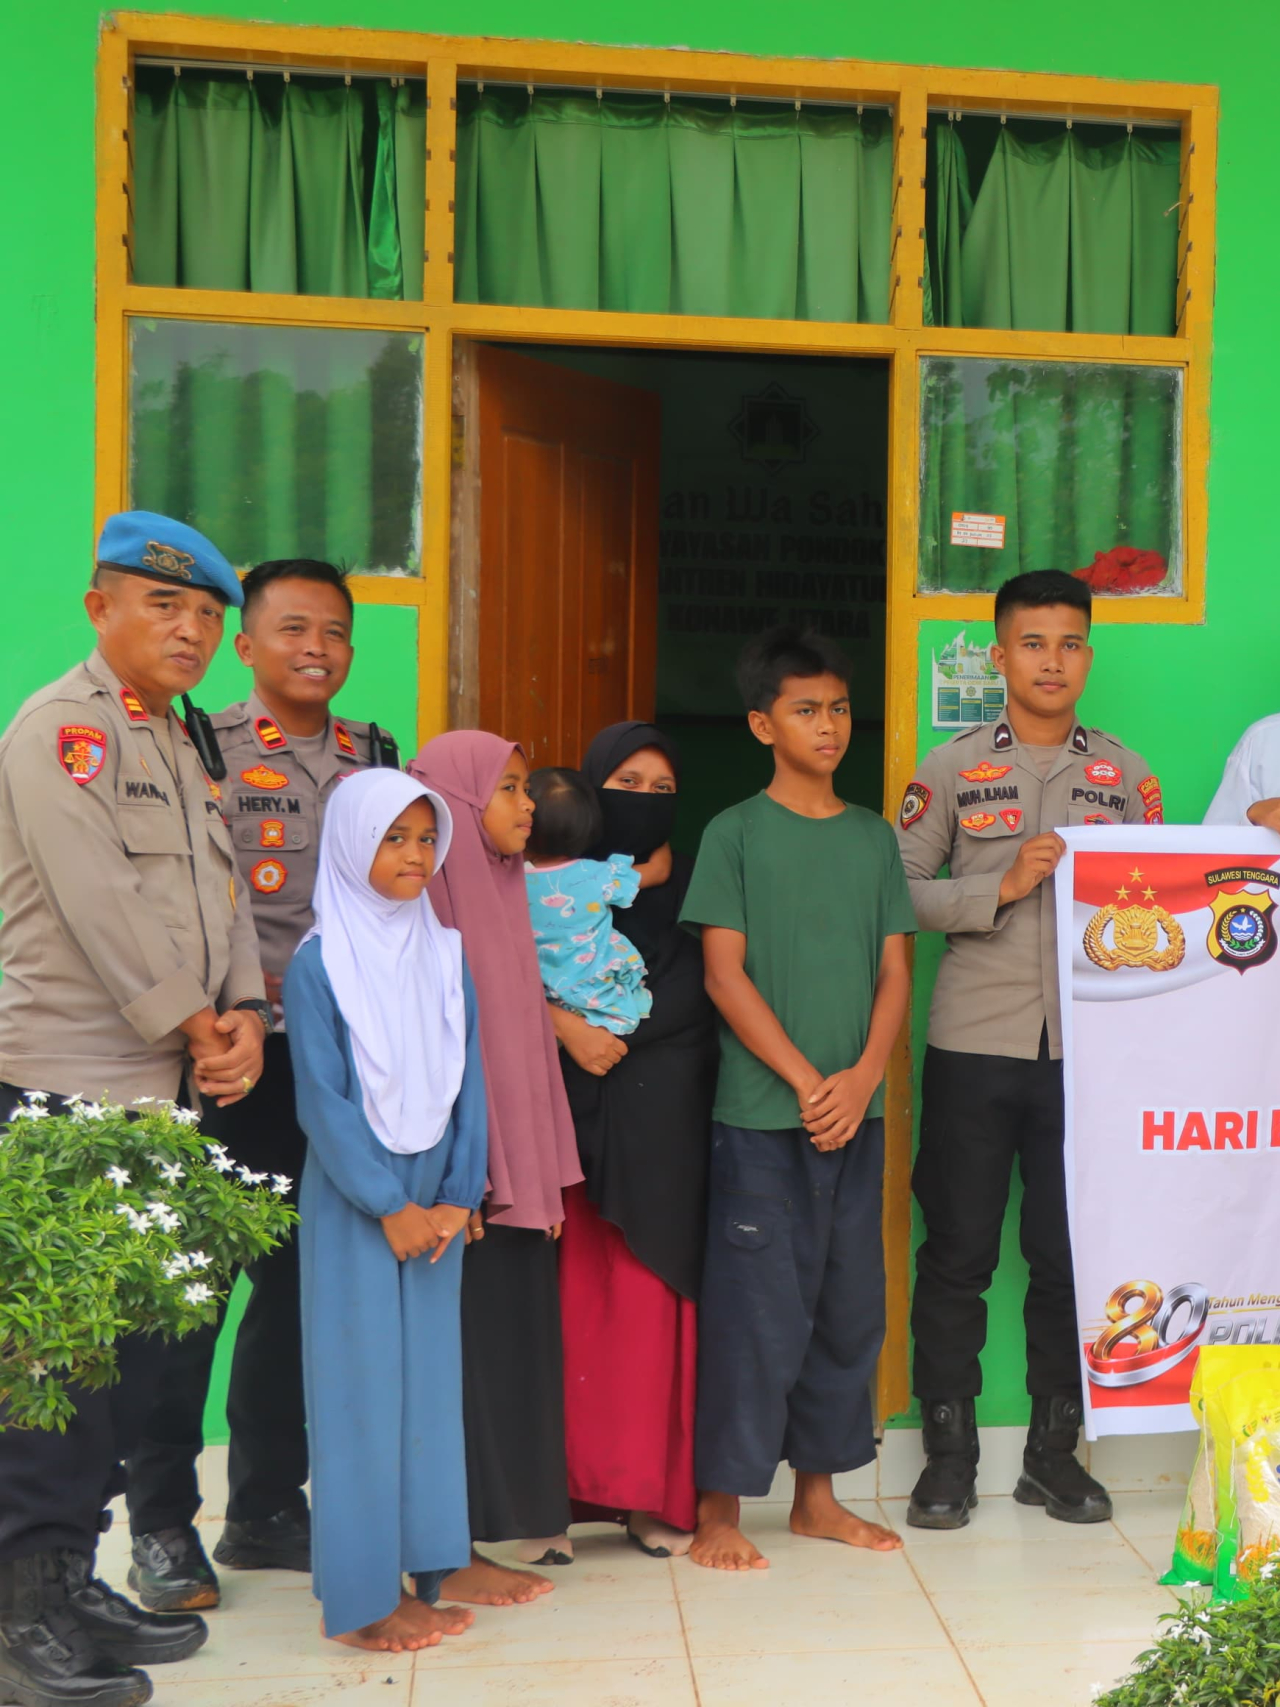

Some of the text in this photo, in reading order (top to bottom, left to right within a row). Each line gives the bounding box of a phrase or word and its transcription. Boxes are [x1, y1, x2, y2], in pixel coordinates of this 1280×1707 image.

[664, 490, 710, 521] an
[65, 727, 103, 741] PROPAM
[957, 785, 1019, 809] MUH.ILHAM
[1072, 788, 1126, 812] POLRI
[1207, 870, 1280, 886] SULAWESI TENGGARA
[1142, 1110, 1258, 1151] HARI
[1208, 1296, 1244, 1310] Tahun
